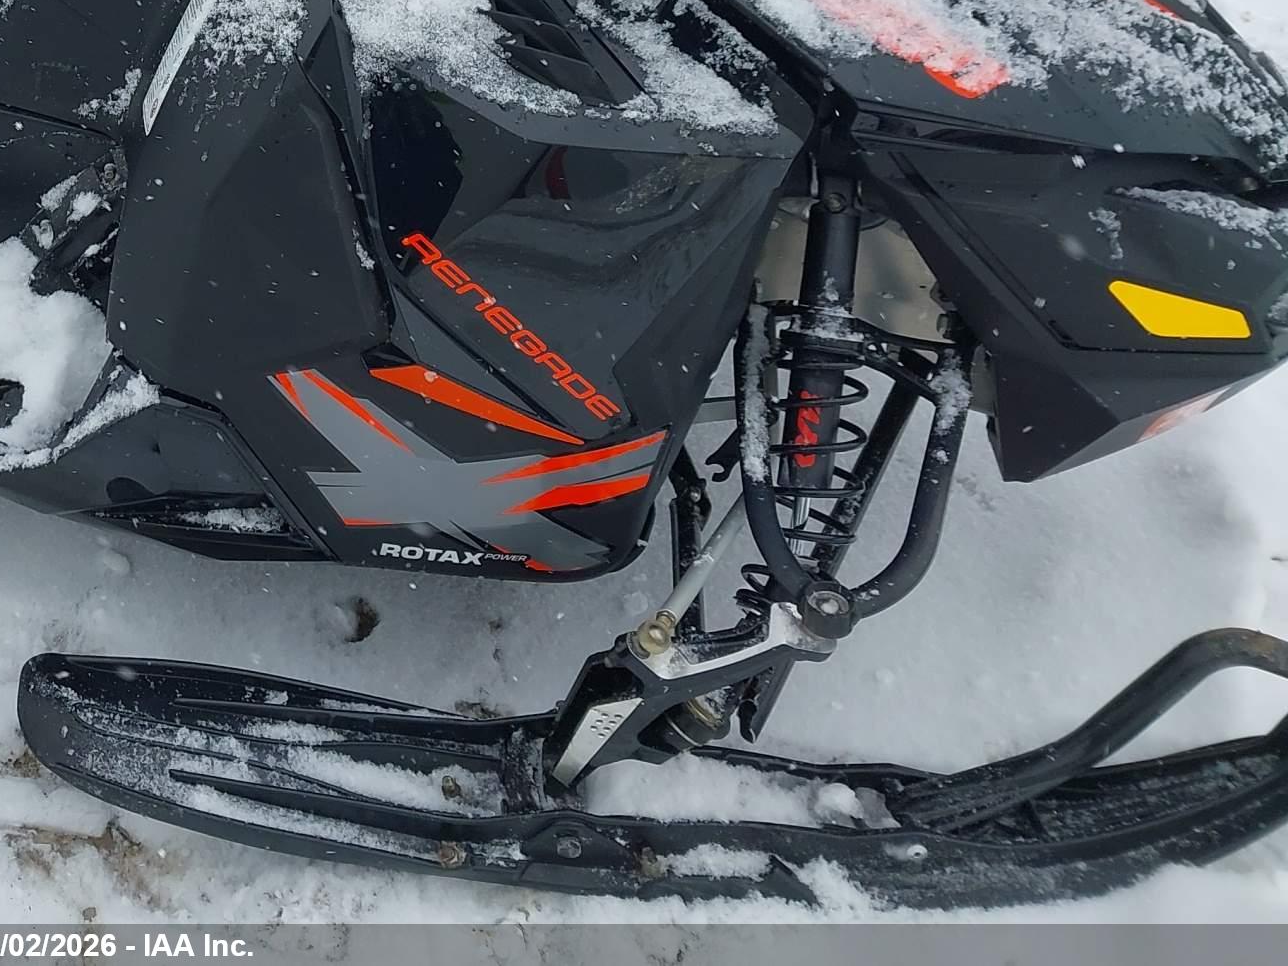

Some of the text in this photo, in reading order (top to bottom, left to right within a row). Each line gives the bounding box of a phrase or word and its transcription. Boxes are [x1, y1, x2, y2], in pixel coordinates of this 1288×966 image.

[401, 233, 621, 420] RENEGADE
[379, 542, 528, 566] ROTAX POWER
